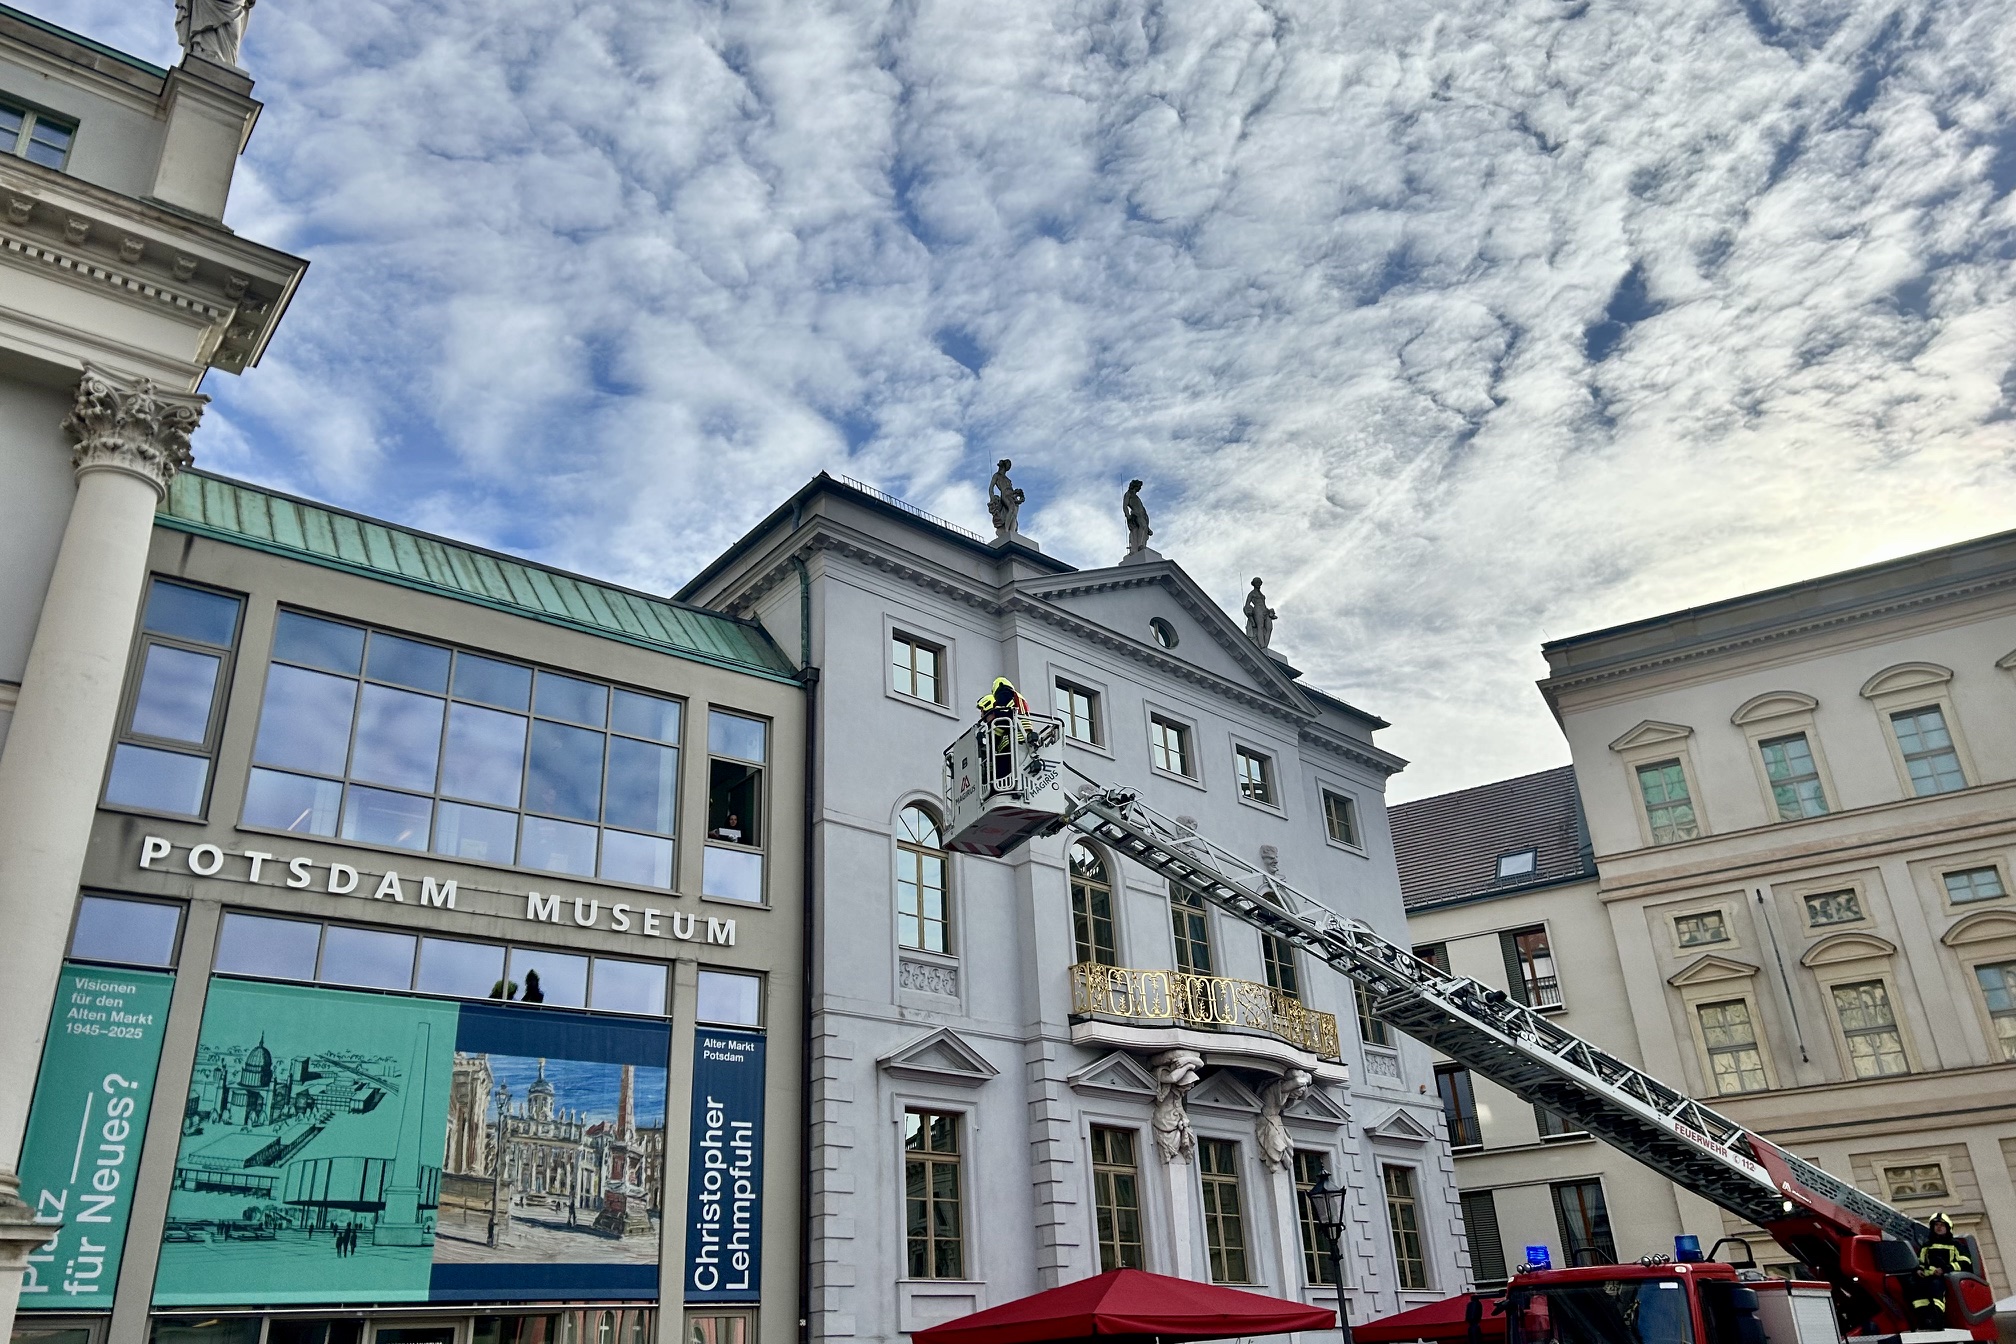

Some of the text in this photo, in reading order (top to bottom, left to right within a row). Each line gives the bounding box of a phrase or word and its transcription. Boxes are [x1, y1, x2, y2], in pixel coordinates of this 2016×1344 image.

[1030, 770, 1058, 798] MAGIRUS
[139, 836, 736, 946] POTSDAM MUSEUM
[71, 992, 123, 1008] für den
[75, 978, 136, 994] Visionen
[67, 1007, 153, 1025] Alten Markt
[703, 1038, 755, 1051] Alter Markt
[703, 1050, 744, 1062] Potsdam
[1674, 1122, 1756, 1172] FEUERWEHR 112
[63, 1073, 139, 1296] für Neues?
[694, 1096, 727, 1291] Christopher
[726, 1121, 756, 1290] Lehmpfuhl
